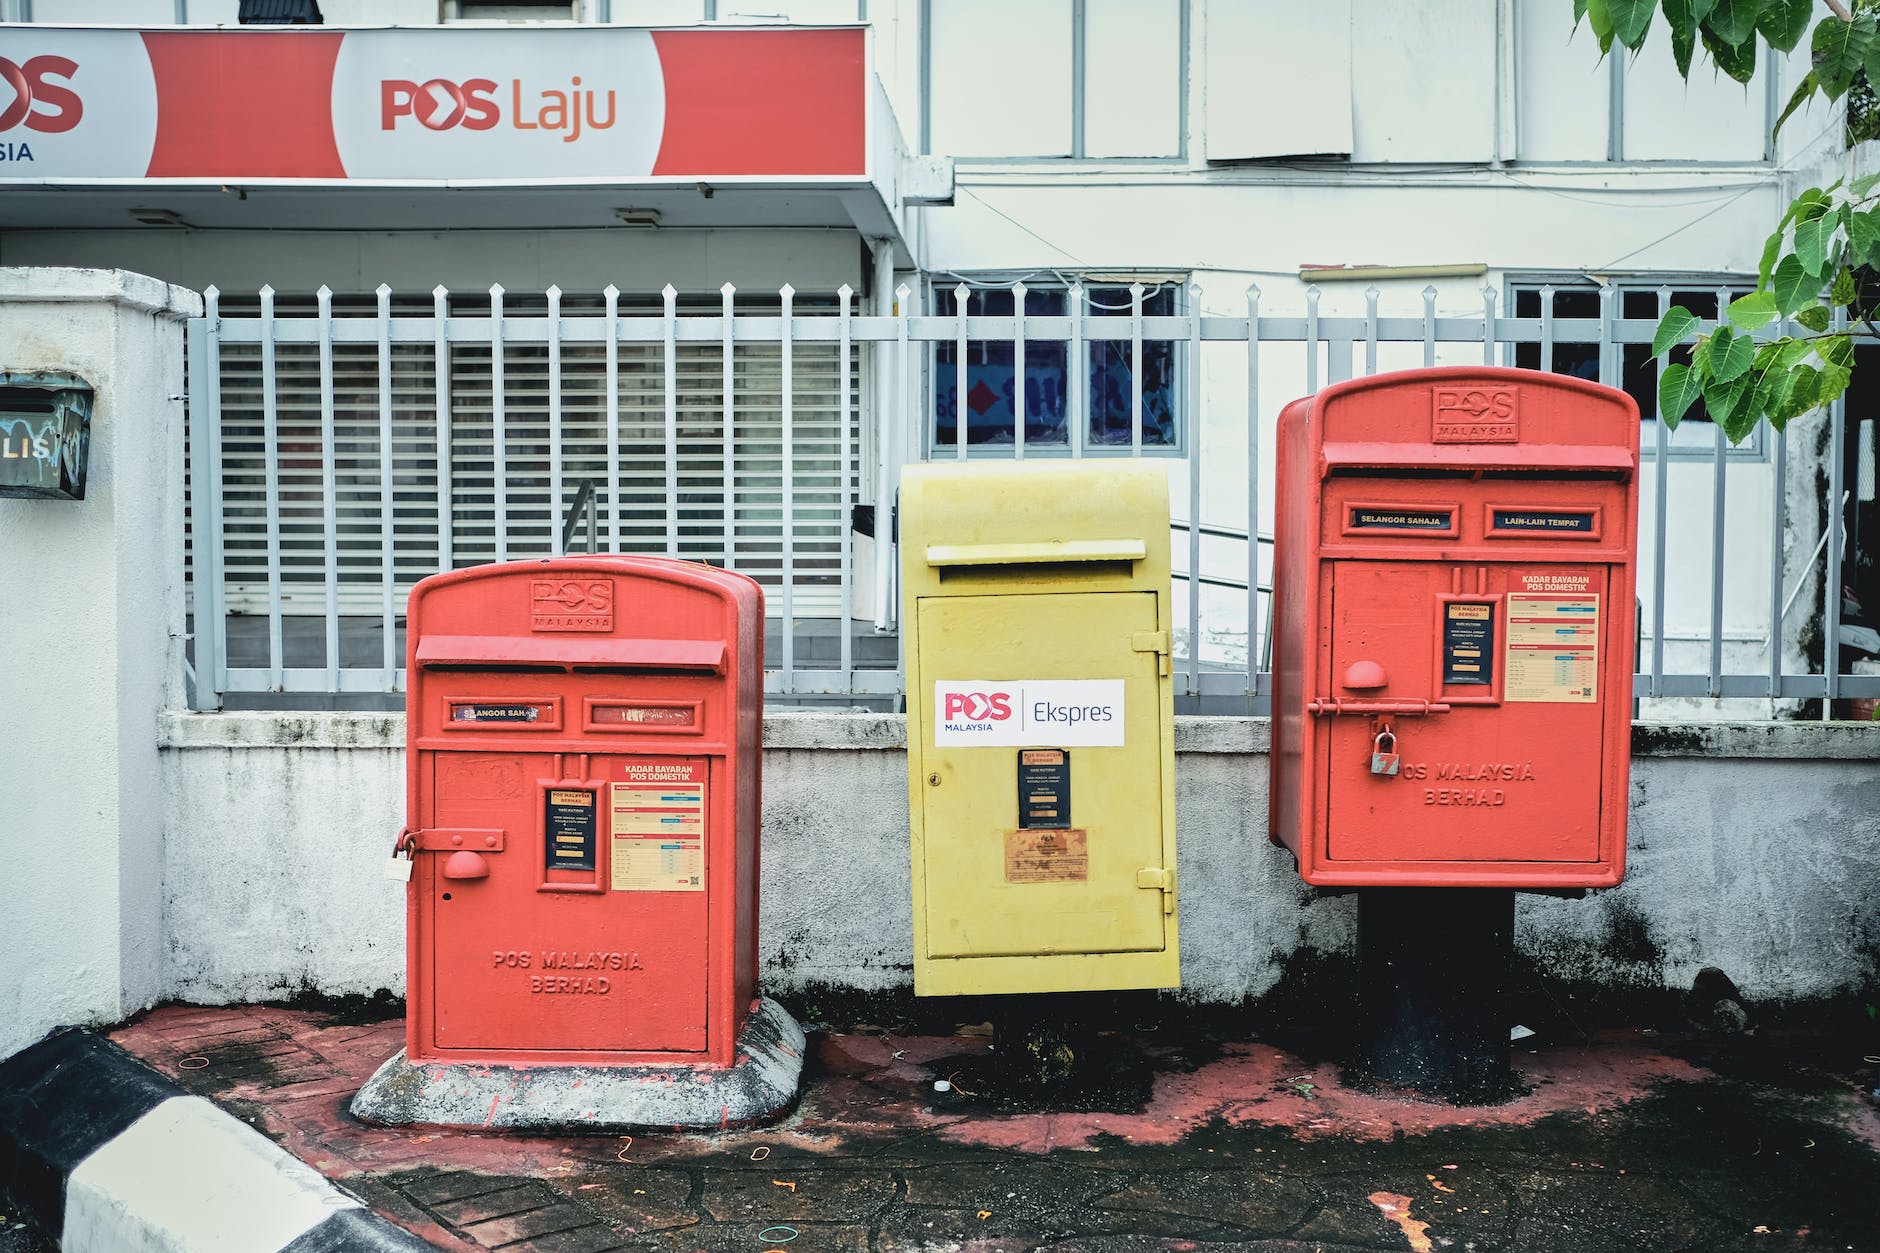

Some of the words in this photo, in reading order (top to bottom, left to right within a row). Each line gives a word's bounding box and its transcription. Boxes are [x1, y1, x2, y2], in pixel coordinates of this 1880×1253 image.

[381, 78, 501, 131] POS
[512, 76, 616, 143] Laju
[1439, 391, 1514, 421] POS
[1438, 427, 1513, 436] MALAYSIA
[1361, 515, 1405, 523] SELANGOR
[1407, 517, 1441, 525] SAHAJA
[1504, 518, 1546, 526] LAIN-LAIN
[1548, 519, 1580, 527] TEMPAT
[1522, 575, 1551, 583] KADAR
[1551, 576, 1590, 584] BAYARAN
[1527, 583, 1544, 591] POS
[1544, 583, 1587, 591] DOMESTIK
[533, 583, 610, 612] POS
[534, 618, 609, 627] MALAYSIA
[945, 692, 1012, 721] POS
[1034, 702, 1112, 726] Ekspres
[945, 723, 993, 732] MALAYSIA
[625, 765, 654, 773] KADAR
[1399, 762, 1427, 781] OS
[1436, 763, 1536, 781] MALAYSIA
[648, 773, 690, 781] DOMESTIK
[1423, 788, 1506, 806] BERHAD
[493, 950, 531, 969] POS
[541, 951, 644, 970] MALAYSIA
[530, 975, 611, 994] BERHAD
